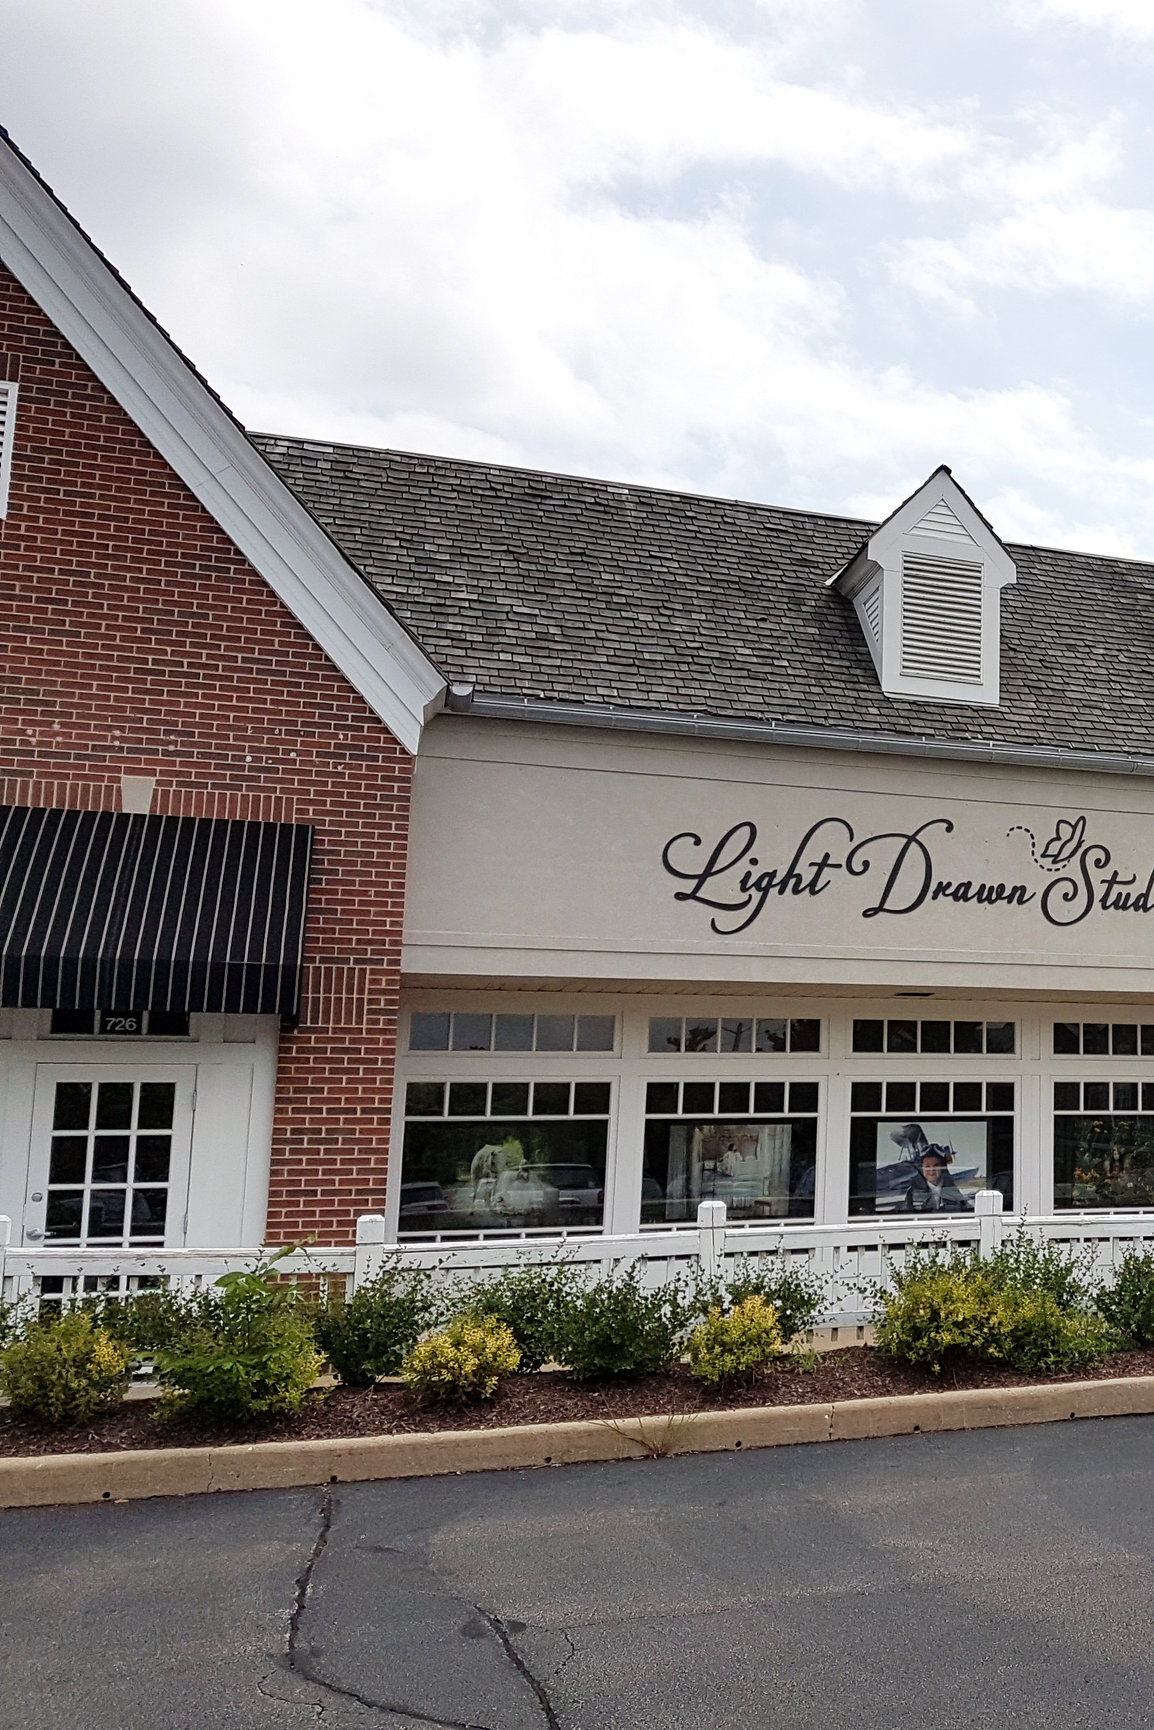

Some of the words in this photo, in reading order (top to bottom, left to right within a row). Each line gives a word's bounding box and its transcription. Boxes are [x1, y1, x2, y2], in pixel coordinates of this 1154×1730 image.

[662, 817, 854, 935] Light
[846, 818, 1036, 919] Drawn
[105, 1017, 137, 1031] 726
